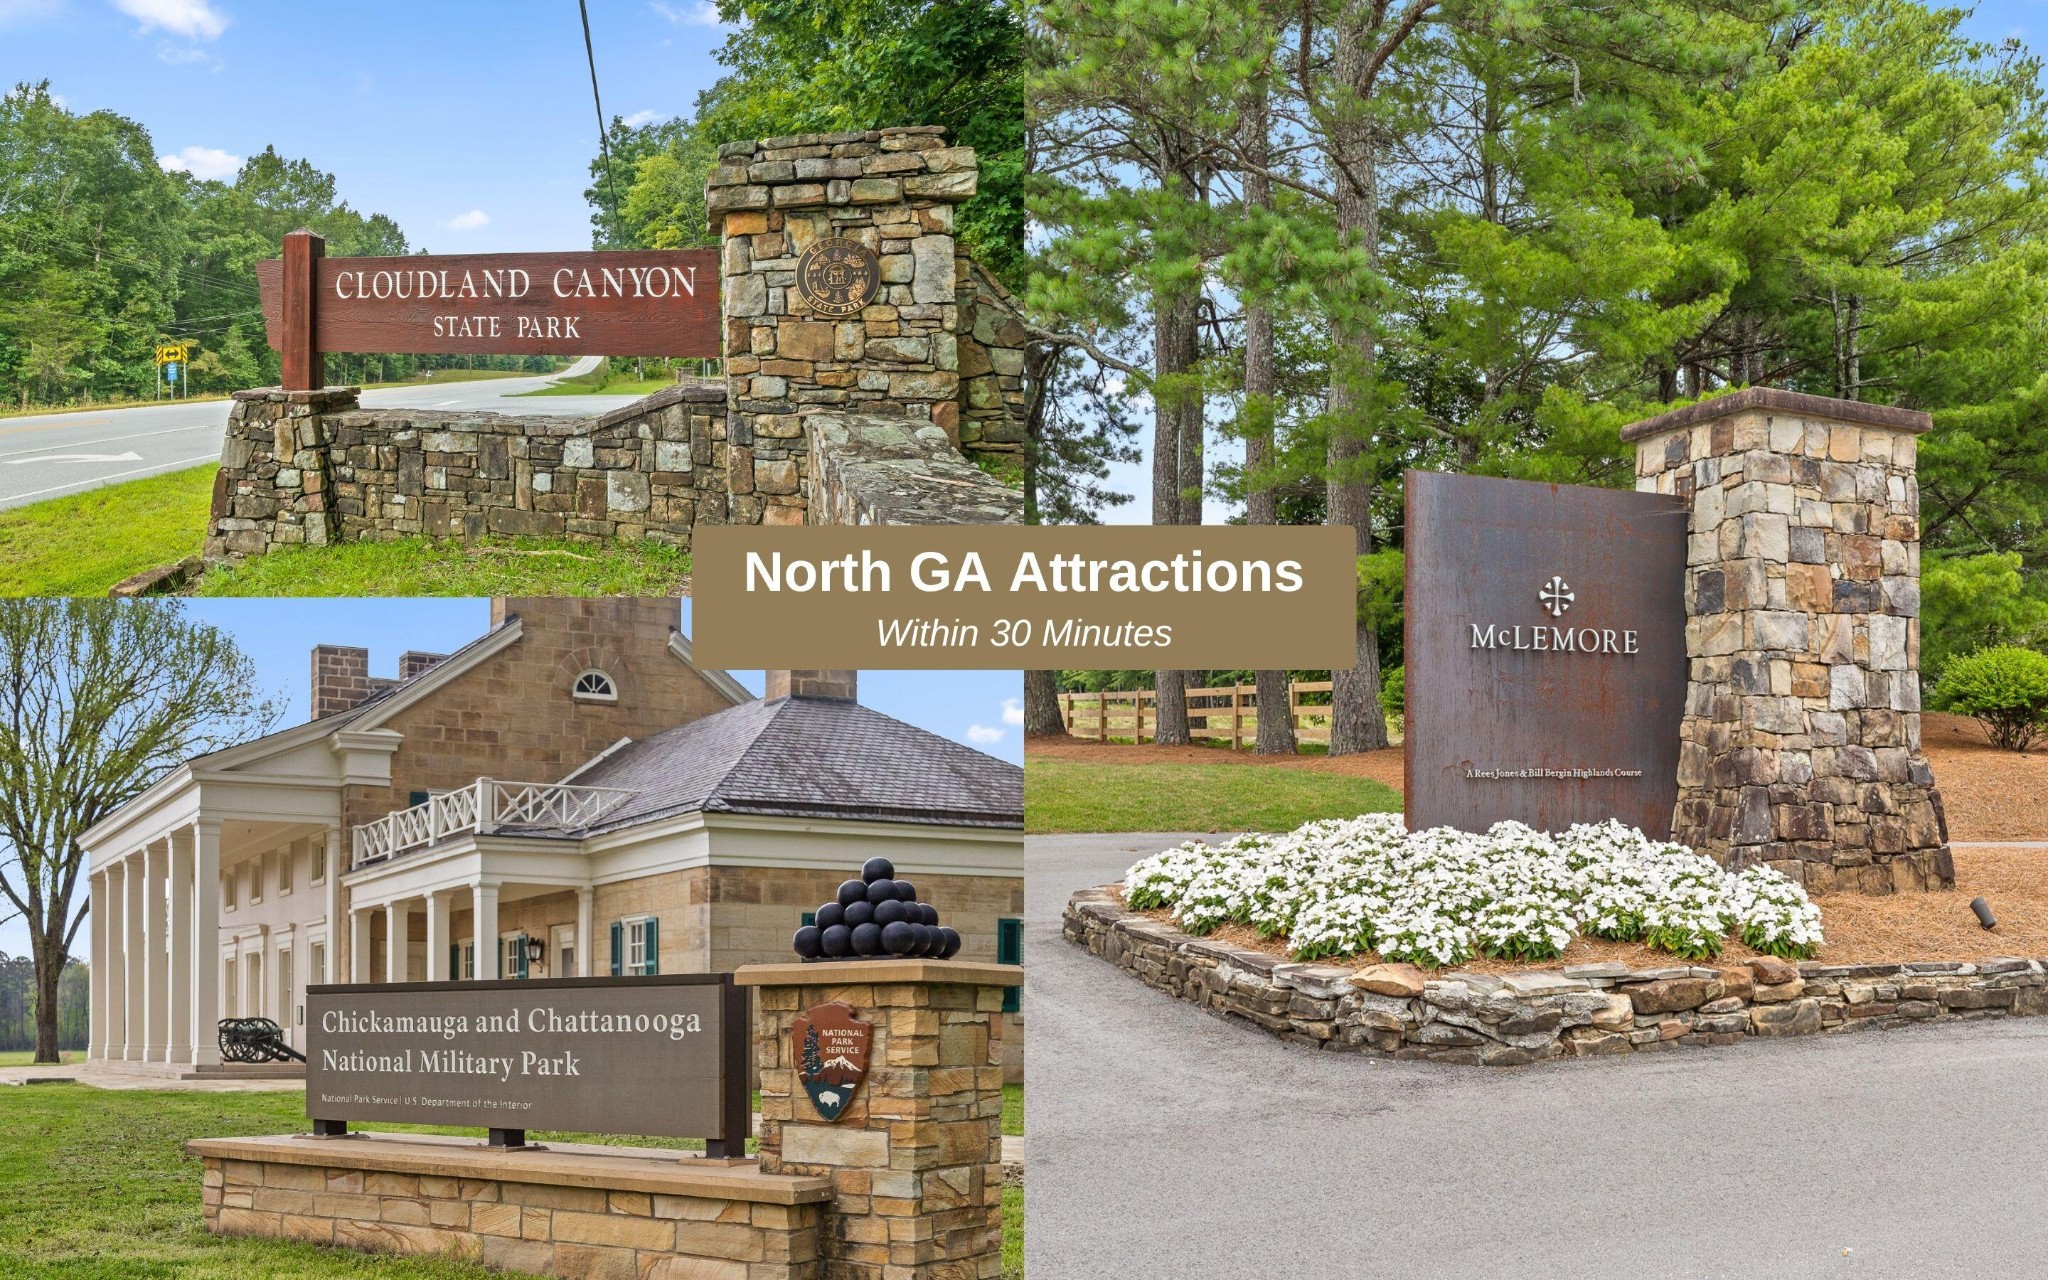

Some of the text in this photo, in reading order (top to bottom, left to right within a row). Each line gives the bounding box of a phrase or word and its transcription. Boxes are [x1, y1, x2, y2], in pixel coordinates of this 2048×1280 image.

[336, 267, 697, 299] CLOUDLAND CANYON
[806, 295, 866, 313] STATE PARK
[433, 316, 581, 339] STATE PARK
[1470, 623, 1639, 654] McLEMORE
[1466, 768, 1643, 780] A Rees Jones & Bill Bergin Highlands Course
[322, 1007, 702, 1041] Chickamauga and Chattanooga
[822, 1029, 865, 1037] NATIONAL
[825, 1046, 860, 1054] SERVICE
[322, 1048, 581, 1082] National Military Park
[321, 1094, 351, 1103] National
[354, 1095, 371, 1104] Park
[372, 1096, 399, 1105] Service
[421, 1097, 471, 1109] Department
[472, 1098, 482, 1108] of
[483, 1098, 498, 1109] the
[500, 1099, 533, 1110] Interior
